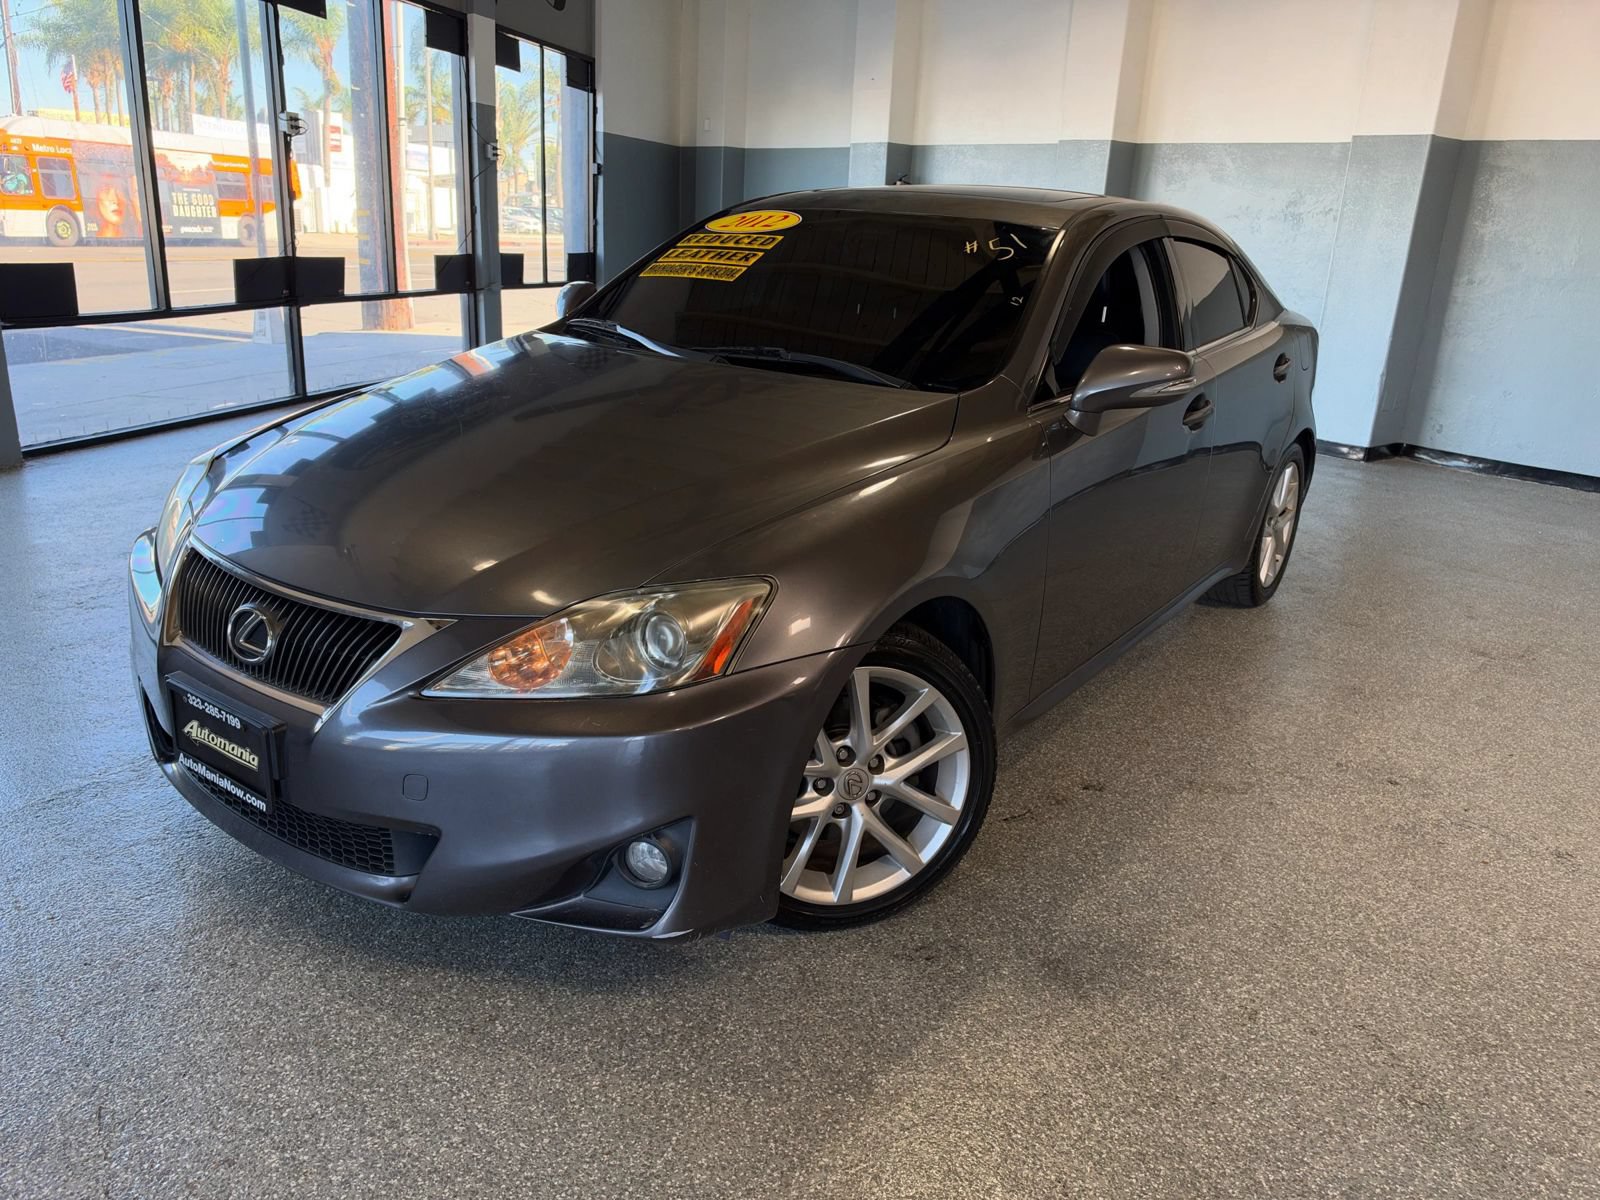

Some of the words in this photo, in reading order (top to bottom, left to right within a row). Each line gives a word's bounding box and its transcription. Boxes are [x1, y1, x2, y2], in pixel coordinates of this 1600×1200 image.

[31, 143, 55, 153] Metro
[171, 192, 188, 205] THE
[191, 194, 215, 206] GOOD
[172, 205, 217, 218] DAUGHTER
[720, 214, 789, 228] 2012
[683, 235, 776, 247] REDUCED
[664, 250, 755, 262] LEATHER
[186, 692, 241, 729] 323-285-7199
[182, 719, 260, 768] Automania
[178, 752, 267, 812] AutoManiaNow.com
